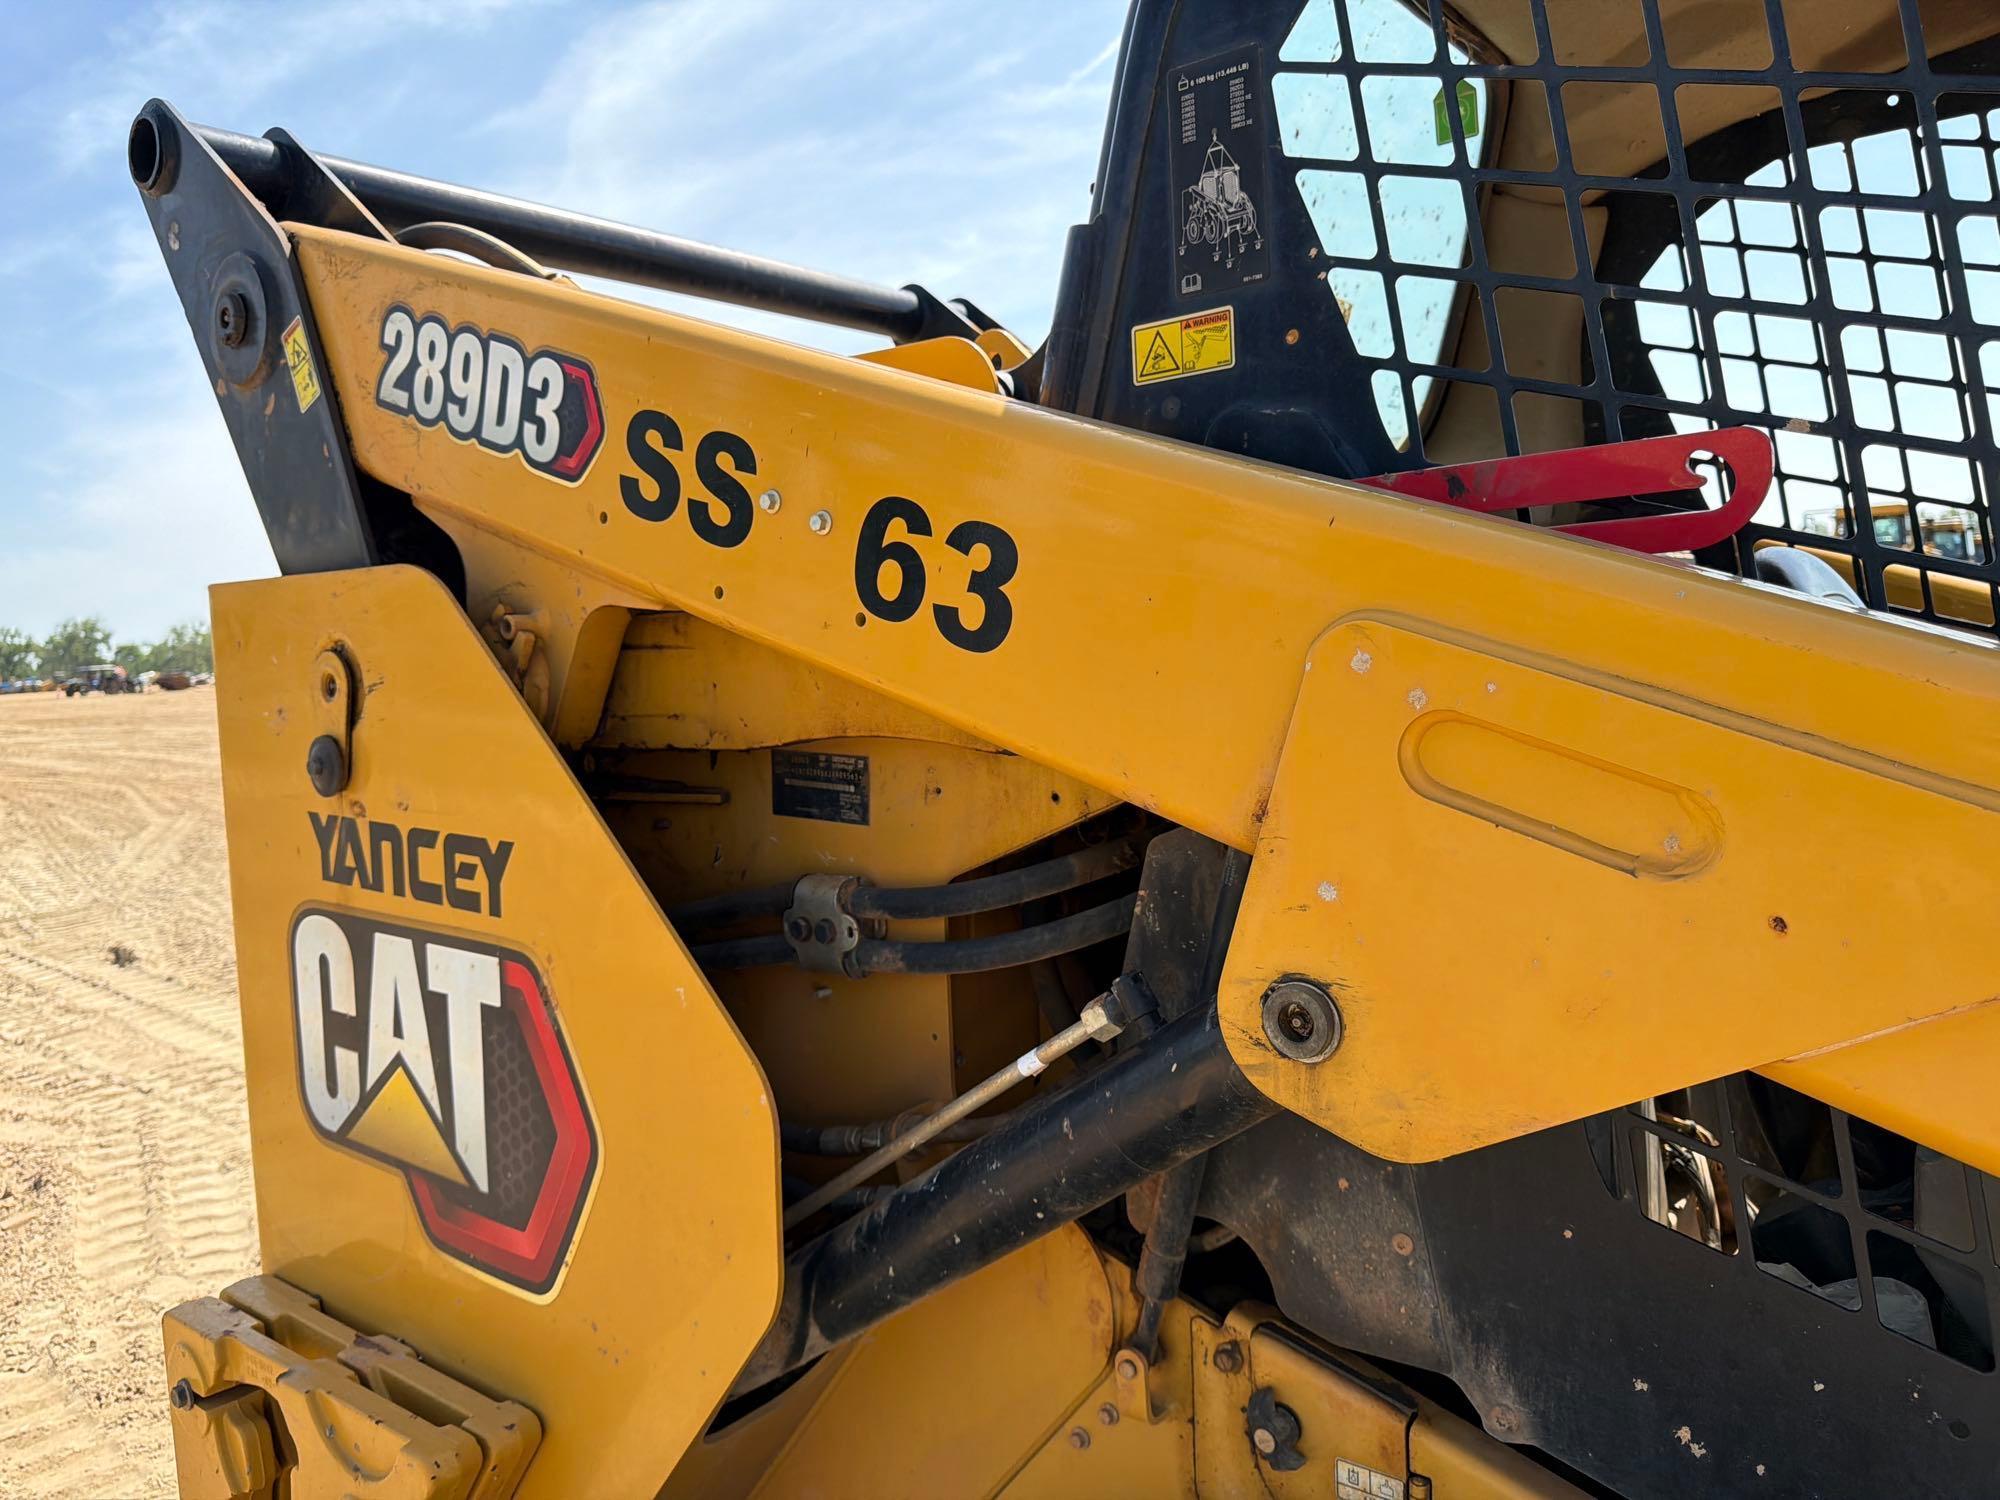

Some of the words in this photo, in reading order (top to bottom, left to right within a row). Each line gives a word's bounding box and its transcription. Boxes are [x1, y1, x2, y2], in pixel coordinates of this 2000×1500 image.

[1238, 62, 1250, 71] LB)
[1192, 313, 1228, 326] WARNING
[377, 310, 565, 463] 289D3
[619, 409, 757, 548] SS
[854, 496, 1019, 653] 63
[307, 811, 515, 918] YANCEY
[293, 914, 502, 1194] CAT
